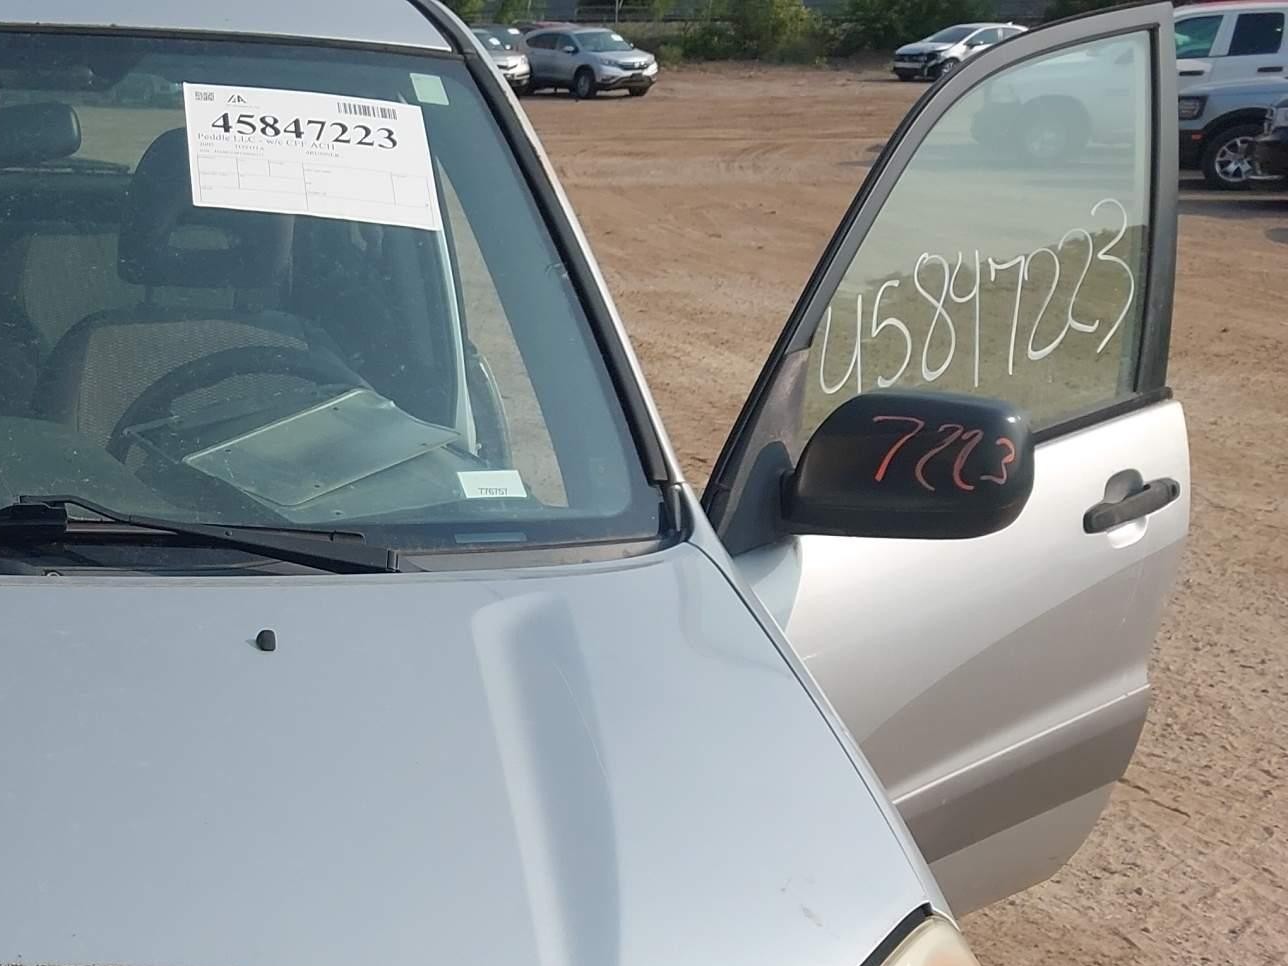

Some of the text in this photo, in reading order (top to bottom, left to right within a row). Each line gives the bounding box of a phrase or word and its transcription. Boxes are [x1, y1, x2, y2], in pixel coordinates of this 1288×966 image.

[198, 133, 230, 141] Peddle
[211, 112, 398, 150] 45847223
[820, 198, 1135, 394] 45847223
[873, 415, 1016, 491] 7223
